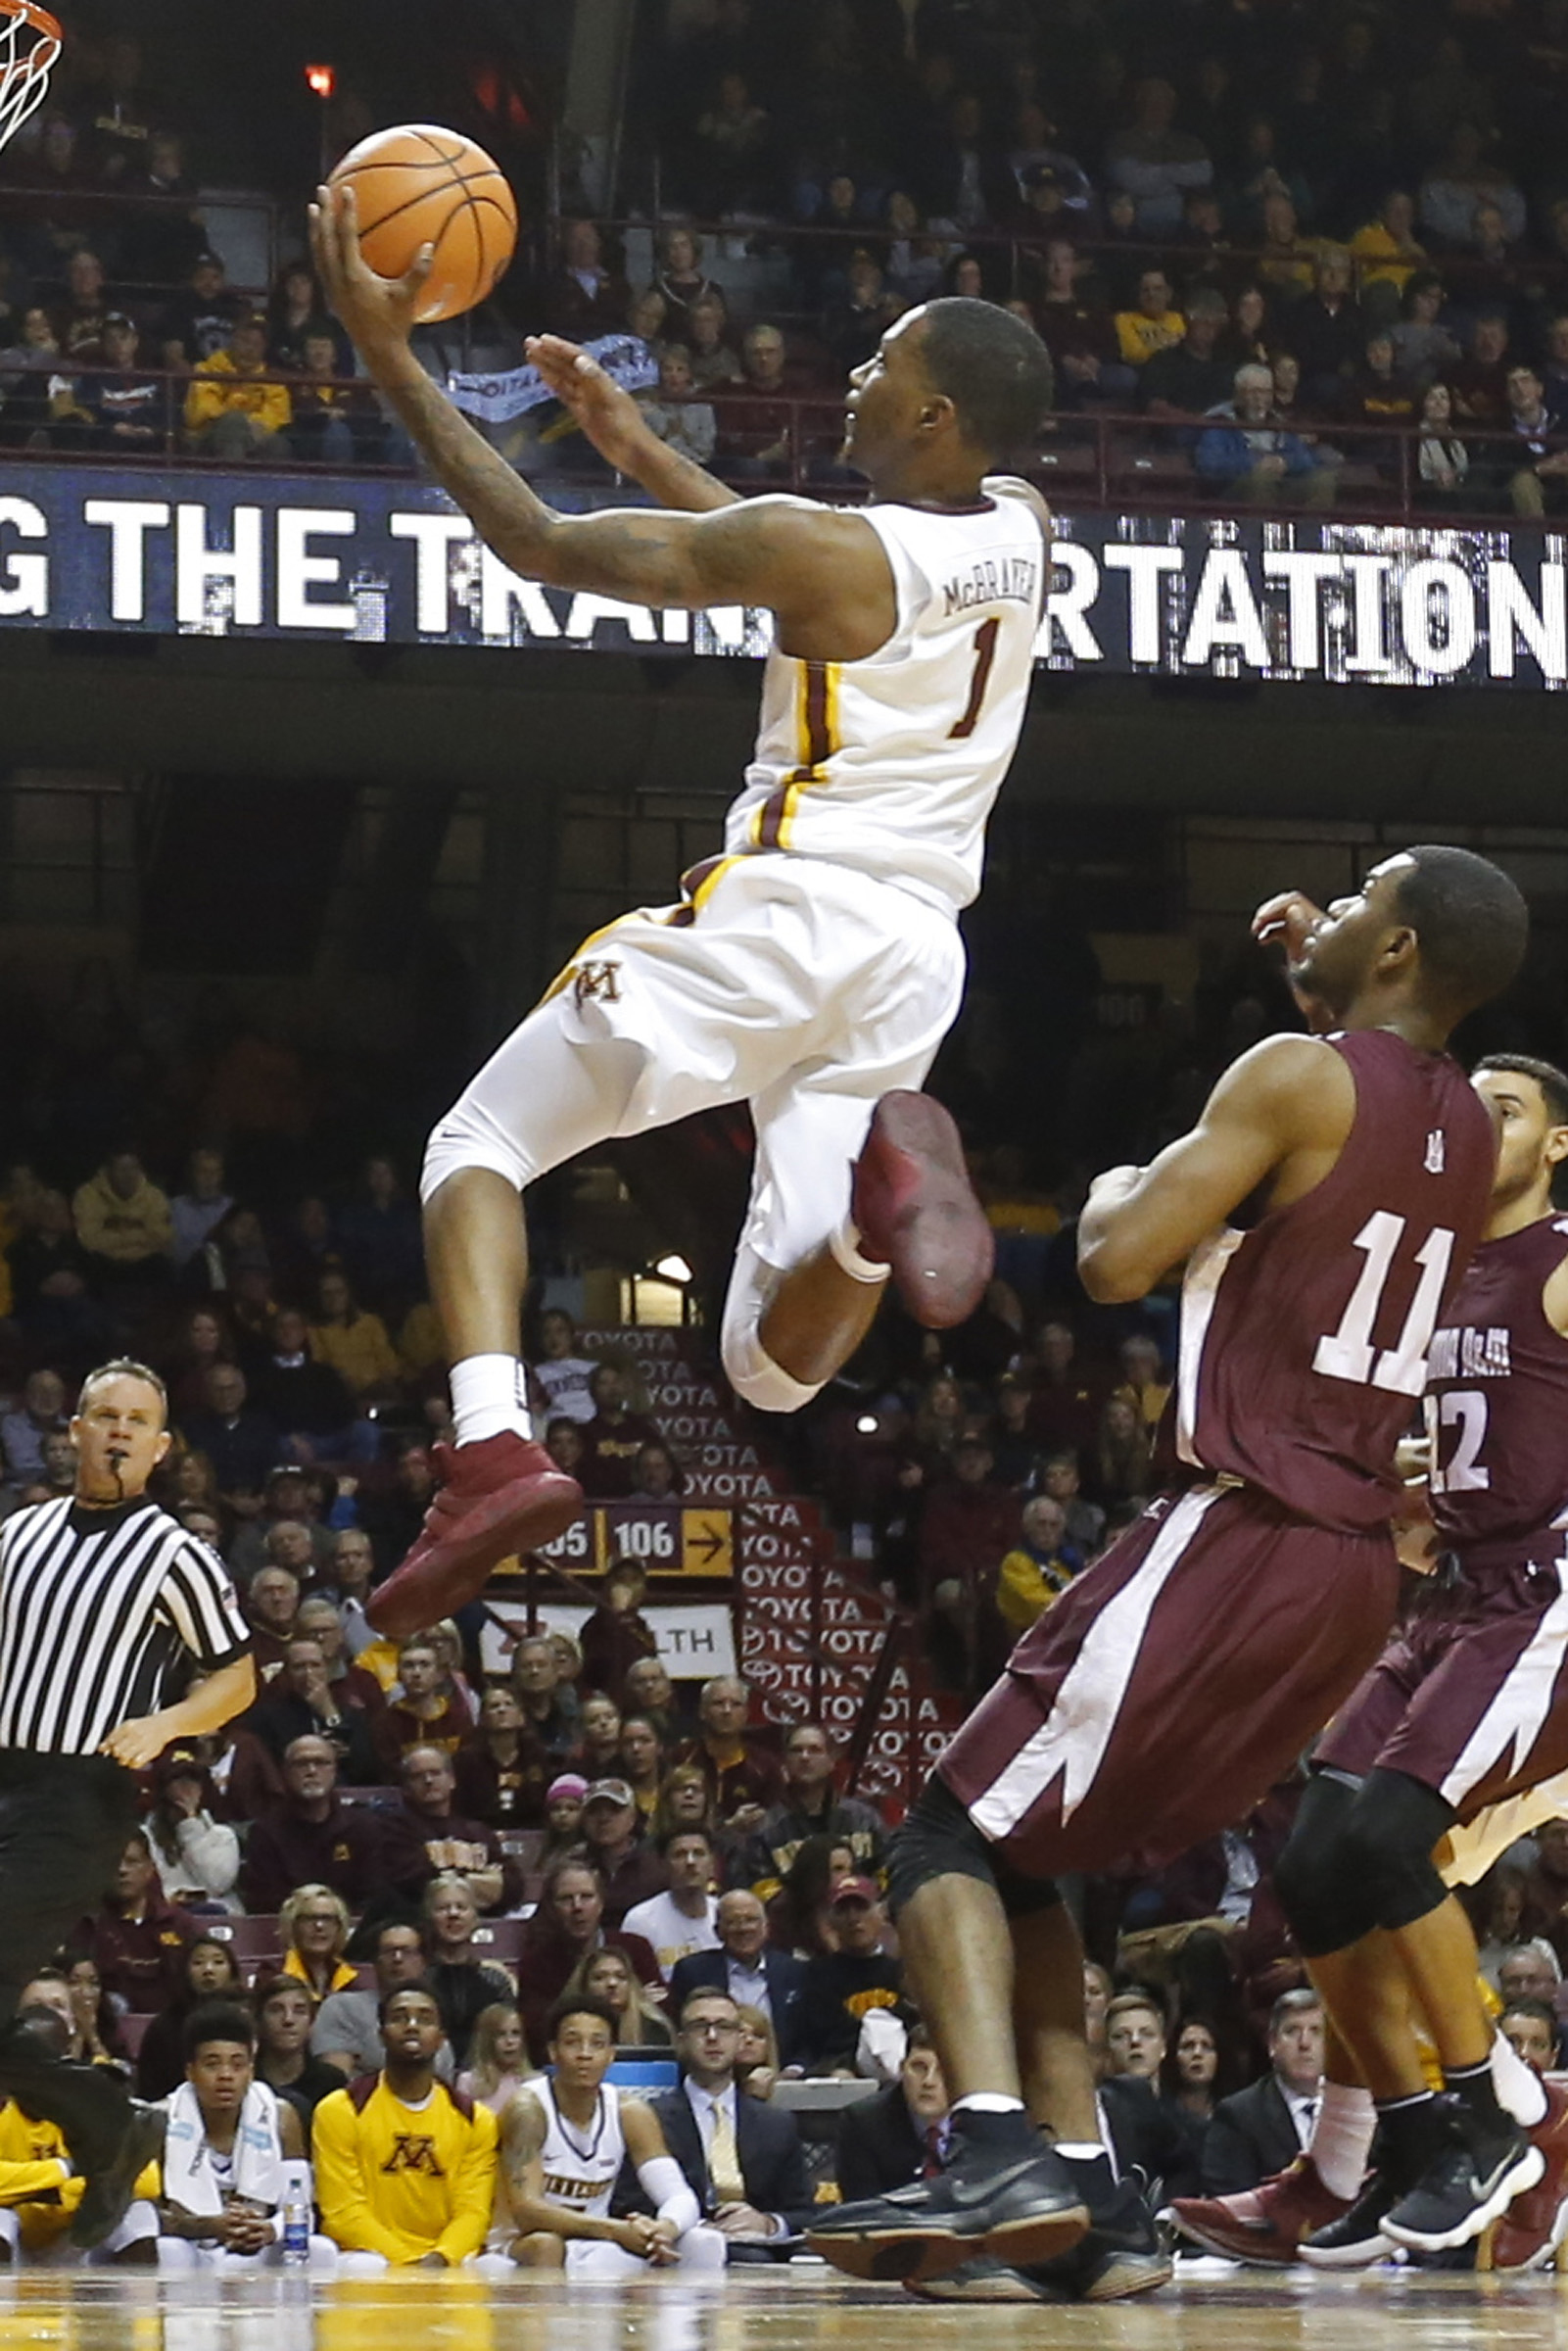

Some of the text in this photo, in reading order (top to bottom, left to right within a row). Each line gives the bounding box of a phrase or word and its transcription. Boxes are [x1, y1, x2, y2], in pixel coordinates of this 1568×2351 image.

[84, 500, 357, 629] THE
[947, 617, 1000, 739] 1
[1311, 1210, 1454, 1398] 11
[645, 1385, 718, 1406] YOTA
[655, 1416, 733, 1437] YOTA
[702, 1444, 760, 1466] OTA
[683, 1473, 773, 1497] OYOTA
[614, 1521, 675, 1558] 106
[741, 1564, 845, 1589] OYOA
[767, 1629, 887, 1654] TOOTA
[821, 1696, 939, 1721] TOOTA
